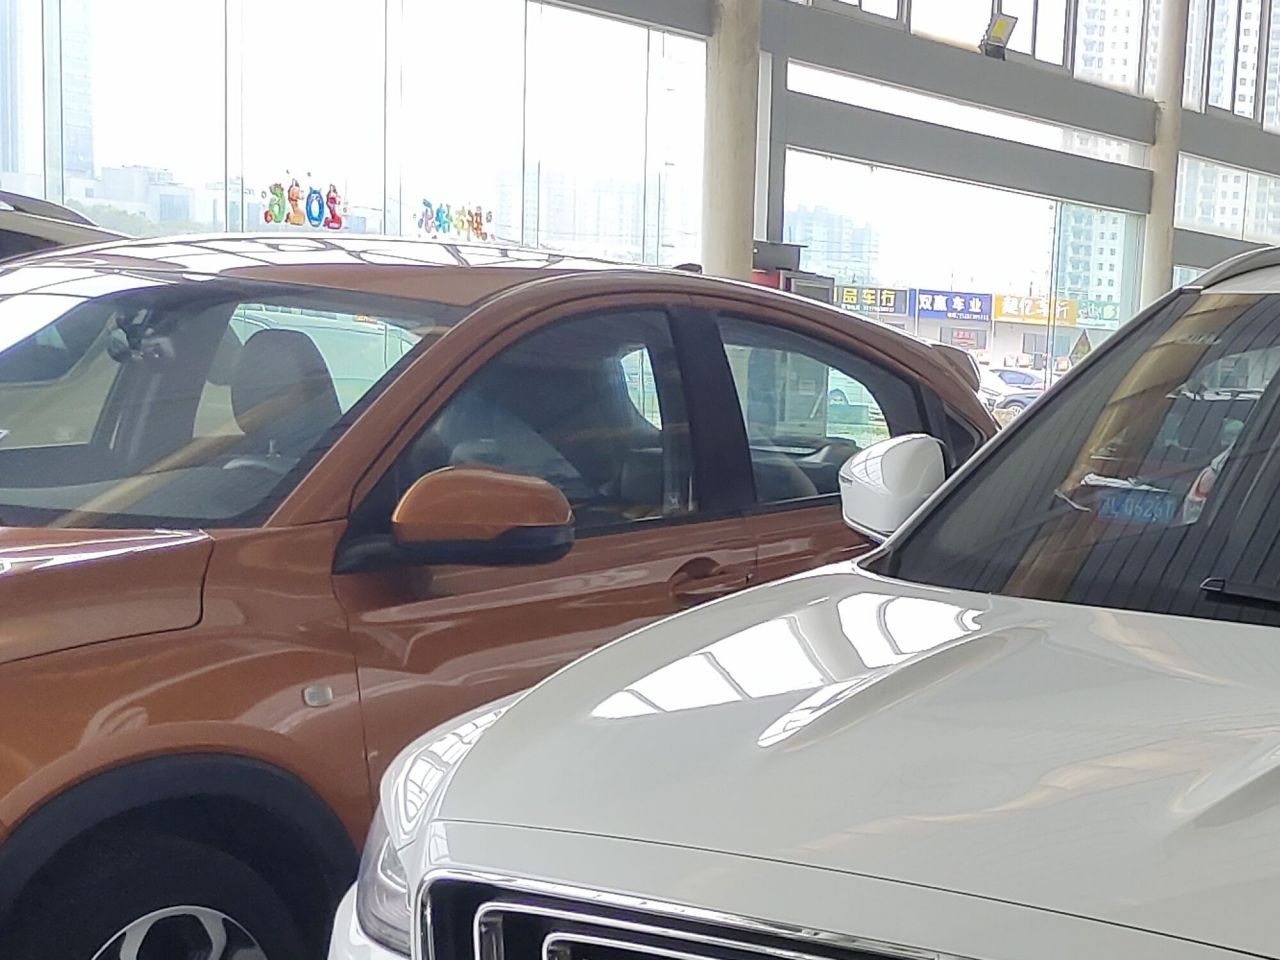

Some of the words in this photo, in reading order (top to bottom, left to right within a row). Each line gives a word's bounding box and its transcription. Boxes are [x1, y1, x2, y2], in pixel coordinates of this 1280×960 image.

[833, 287, 896, 307] 品车行
[918, 294, 983, 313] 双赢车业
